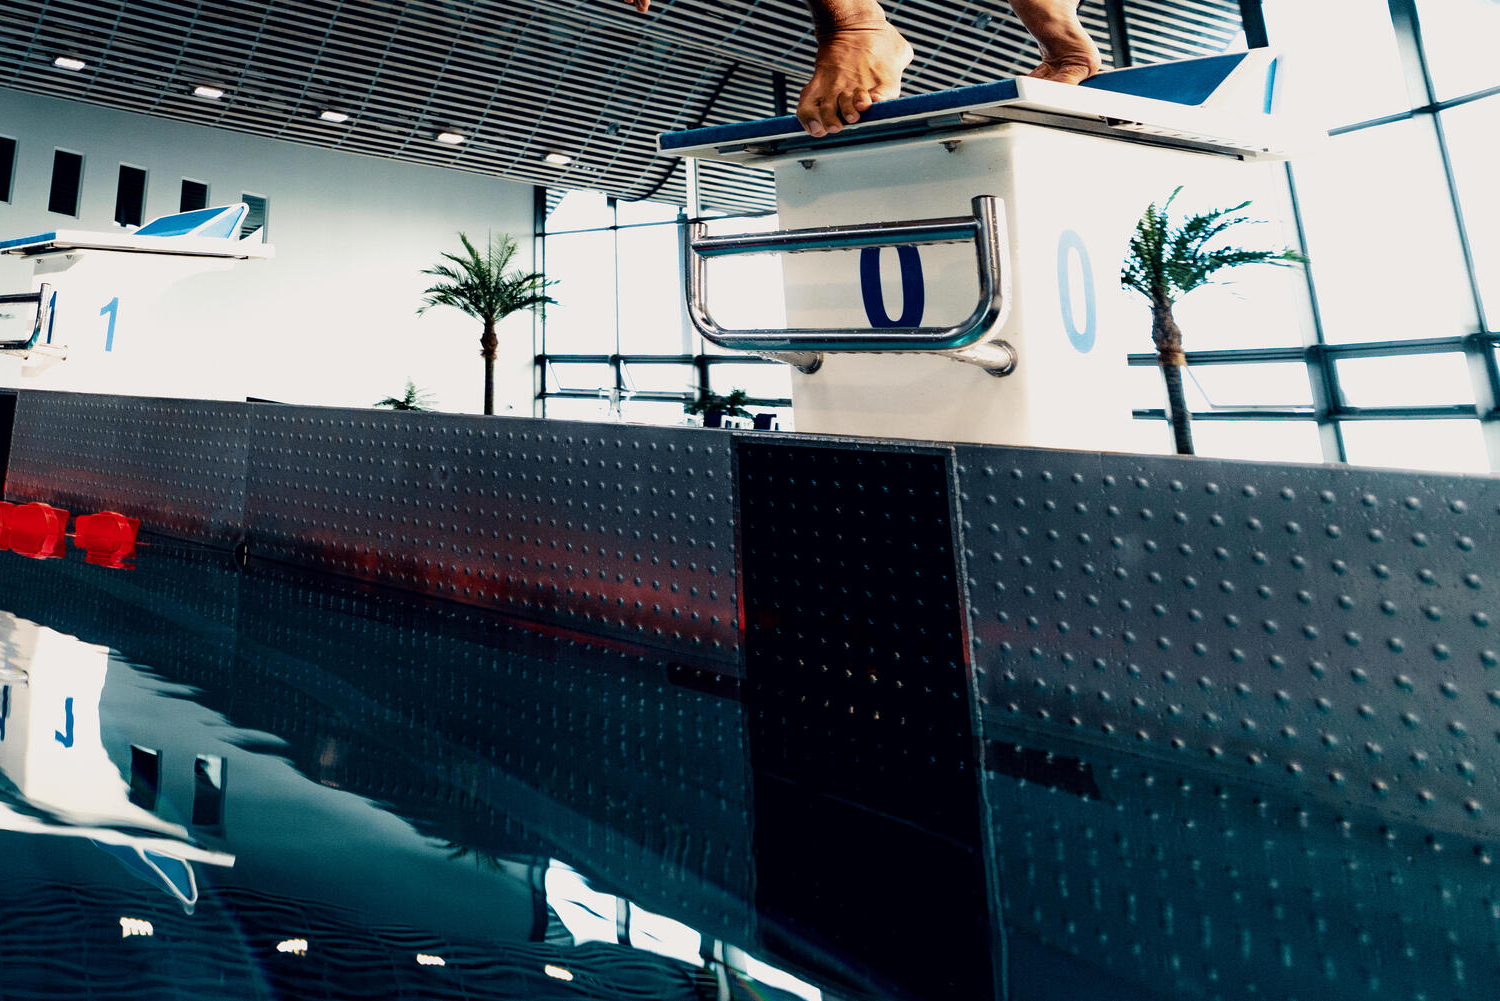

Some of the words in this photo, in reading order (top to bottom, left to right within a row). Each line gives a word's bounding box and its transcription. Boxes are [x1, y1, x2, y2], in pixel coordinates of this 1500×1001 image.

[100, 297, 119, 352] 1
[860, 244, 925, 330] 0
[1058, 229, 1097, 354] 0
